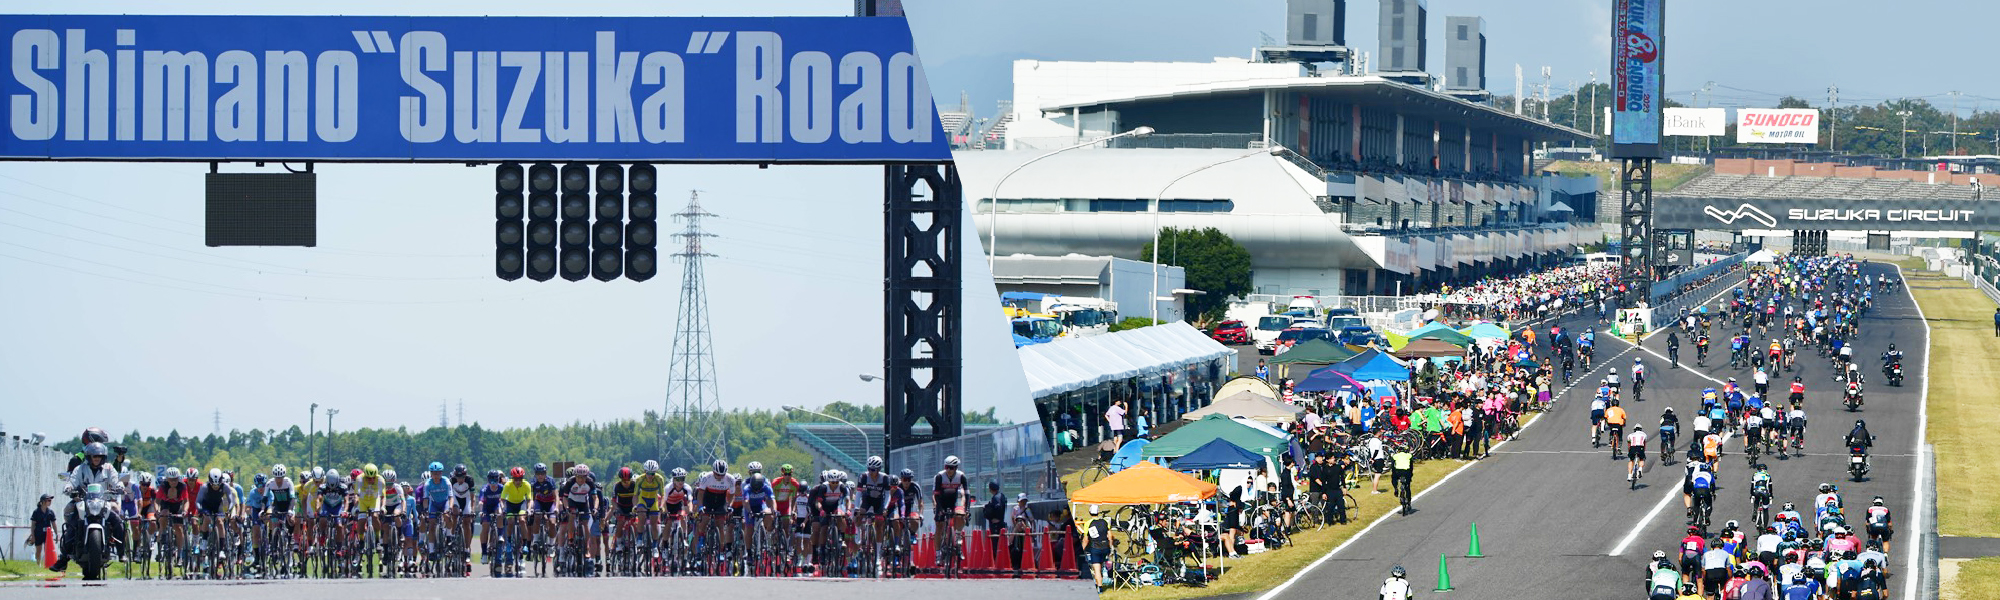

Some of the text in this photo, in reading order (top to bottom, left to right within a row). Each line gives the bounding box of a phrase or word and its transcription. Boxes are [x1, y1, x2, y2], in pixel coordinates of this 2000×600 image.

[10, 28, 358, 142] Shimano
[735, 31, 932, 143] Road
[1627, 58, 1644, 112] ENDURO
[1742, 113, 1814, 127] SUNOCO
[1768, 130, 1793, 138] MOTOR
[1793, 130, 1805, 138] OIL
[1788, 208, 1975, 222] SUZUKA CIRCUIT
